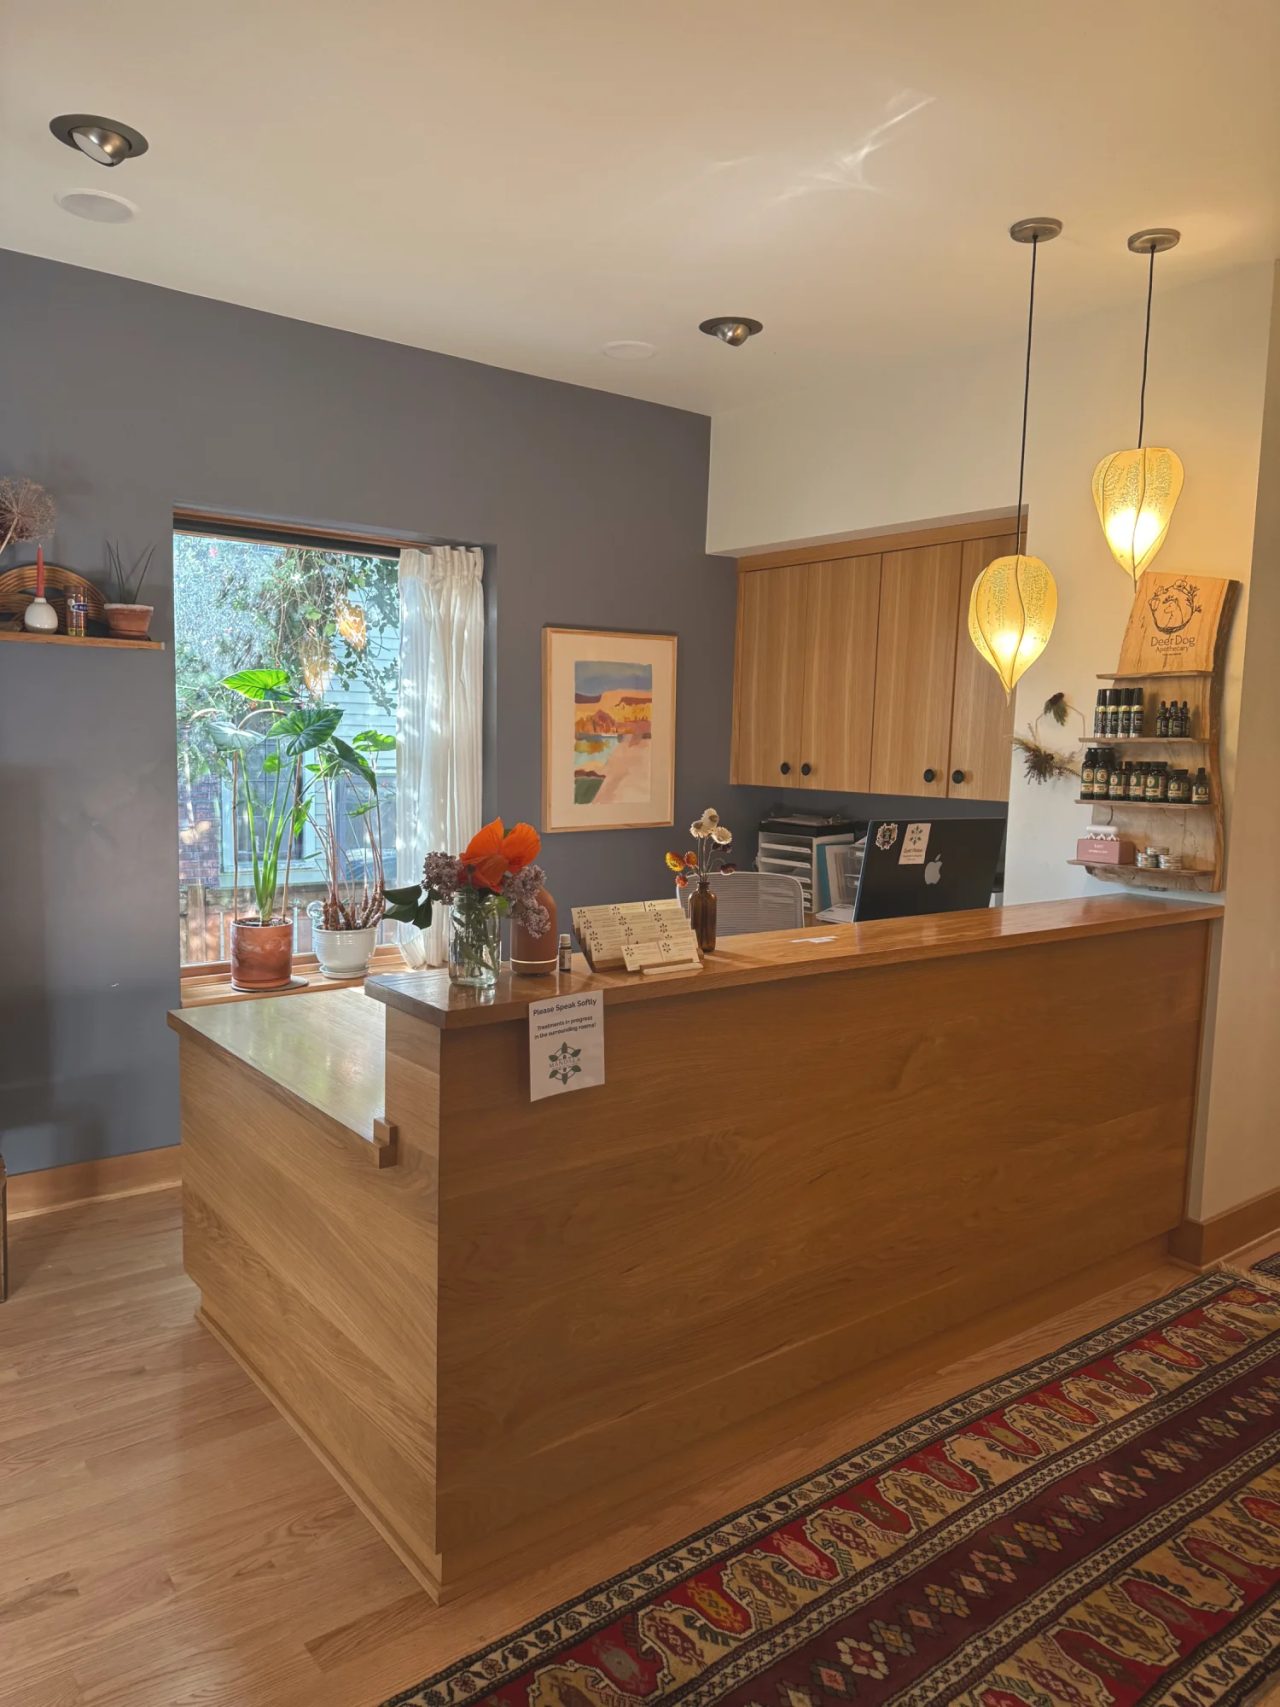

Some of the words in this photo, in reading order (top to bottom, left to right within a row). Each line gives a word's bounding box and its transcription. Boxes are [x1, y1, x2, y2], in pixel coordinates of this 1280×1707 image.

[1150, 636, 1174, 647] Deer
[1175, 634, 1196, 648] Dog
[533, 1006, 555, 1016] Please
[555, 1002, 576, 1012] Speak
[577, 998, 597, 1007] Softly
[570, 1016, 593, 1024] progress
[548, 1025, 578, 1036] surrounding
